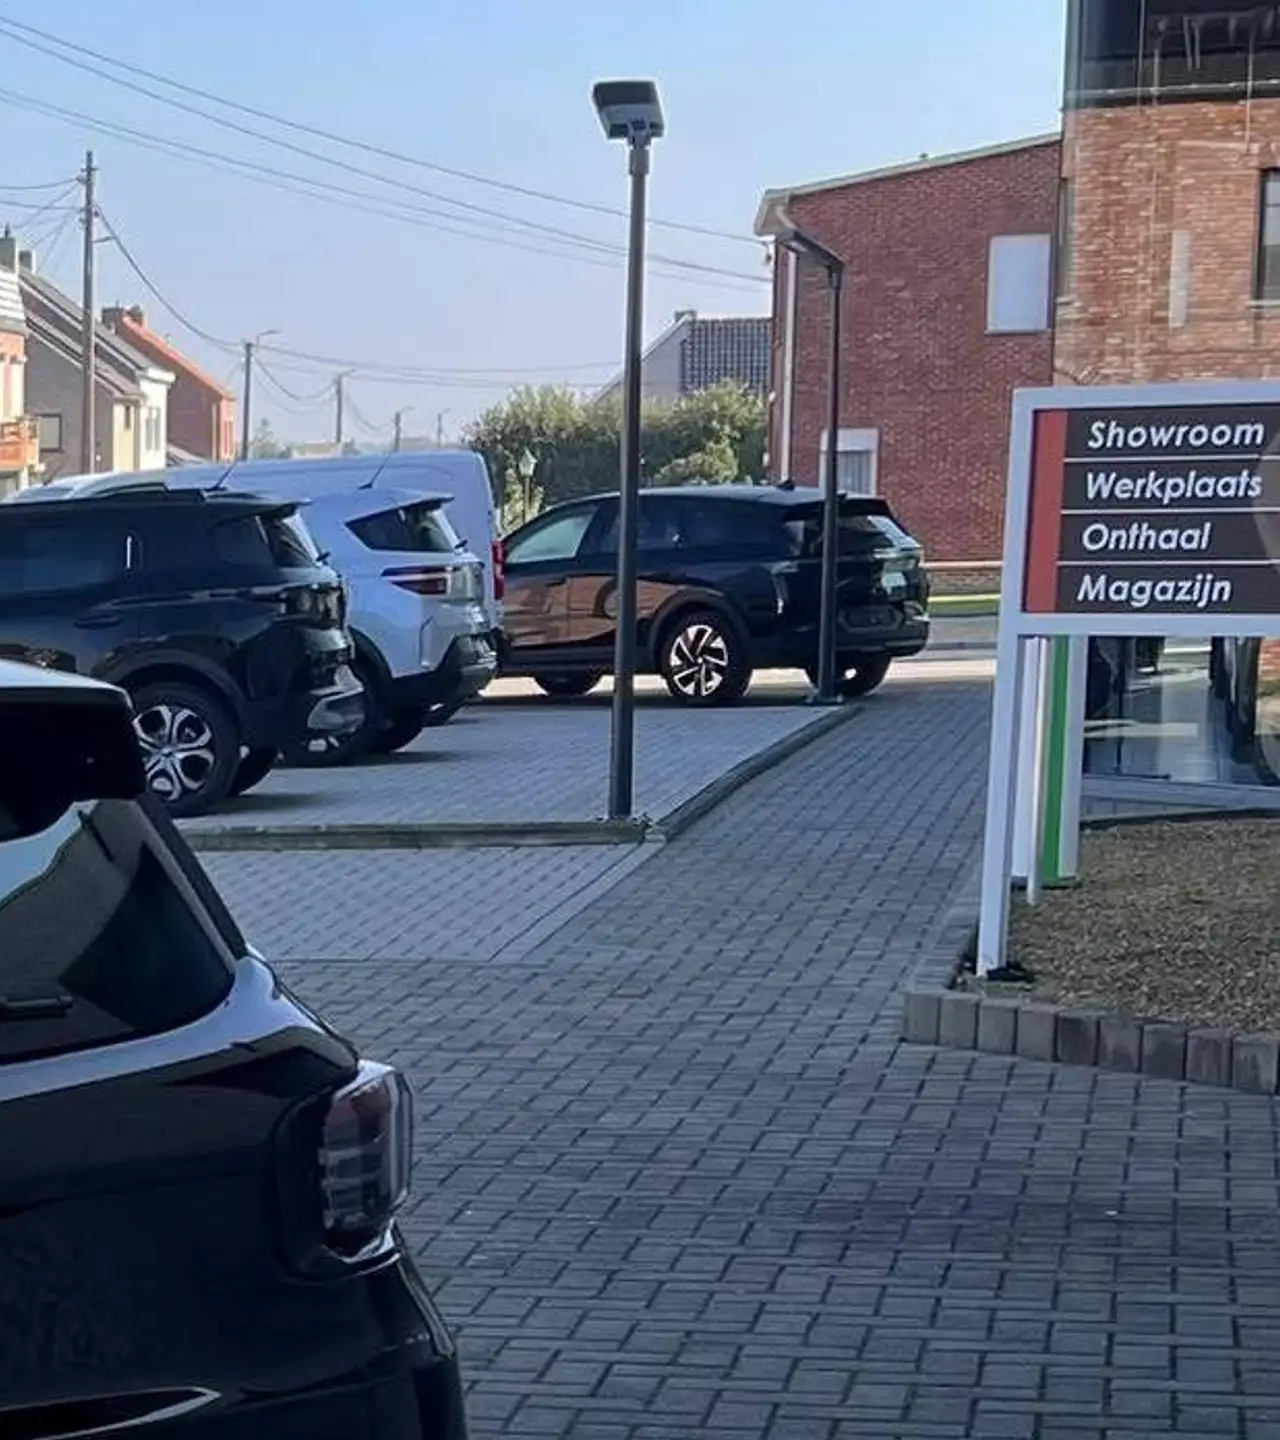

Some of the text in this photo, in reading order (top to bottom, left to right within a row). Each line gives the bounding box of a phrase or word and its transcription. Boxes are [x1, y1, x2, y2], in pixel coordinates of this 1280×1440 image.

[1087, 420, 1266, 450] Showroom
[1086, 469, 1263, 505] Werkplaats
[1082, 521, 1212, 551] Onthaal
[1076, 573, 1232, 609] Magazijn
